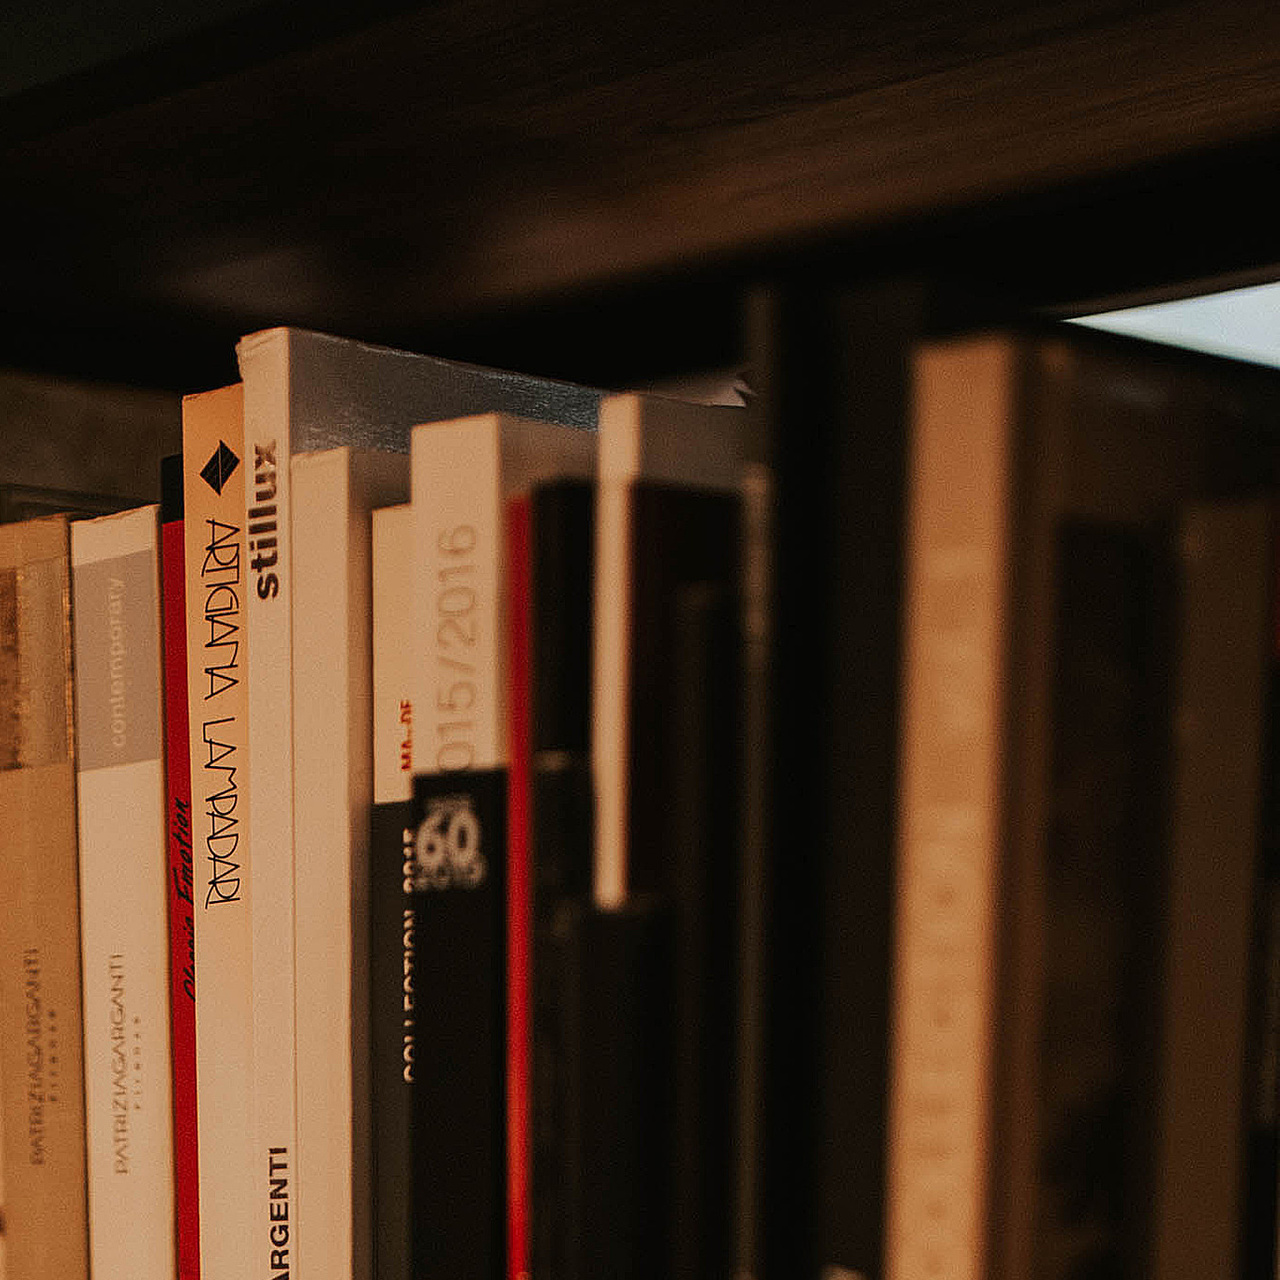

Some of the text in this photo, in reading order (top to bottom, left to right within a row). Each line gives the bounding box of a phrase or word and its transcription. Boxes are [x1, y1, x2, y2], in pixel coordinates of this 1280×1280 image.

[248, 445, 279, 602] stillux
[108, 577, 127, 749] contemporary
[202, 518, 241, 910] ARTIGIANA LAMPADARI
[436, 523, 477, 773] 015/2016
